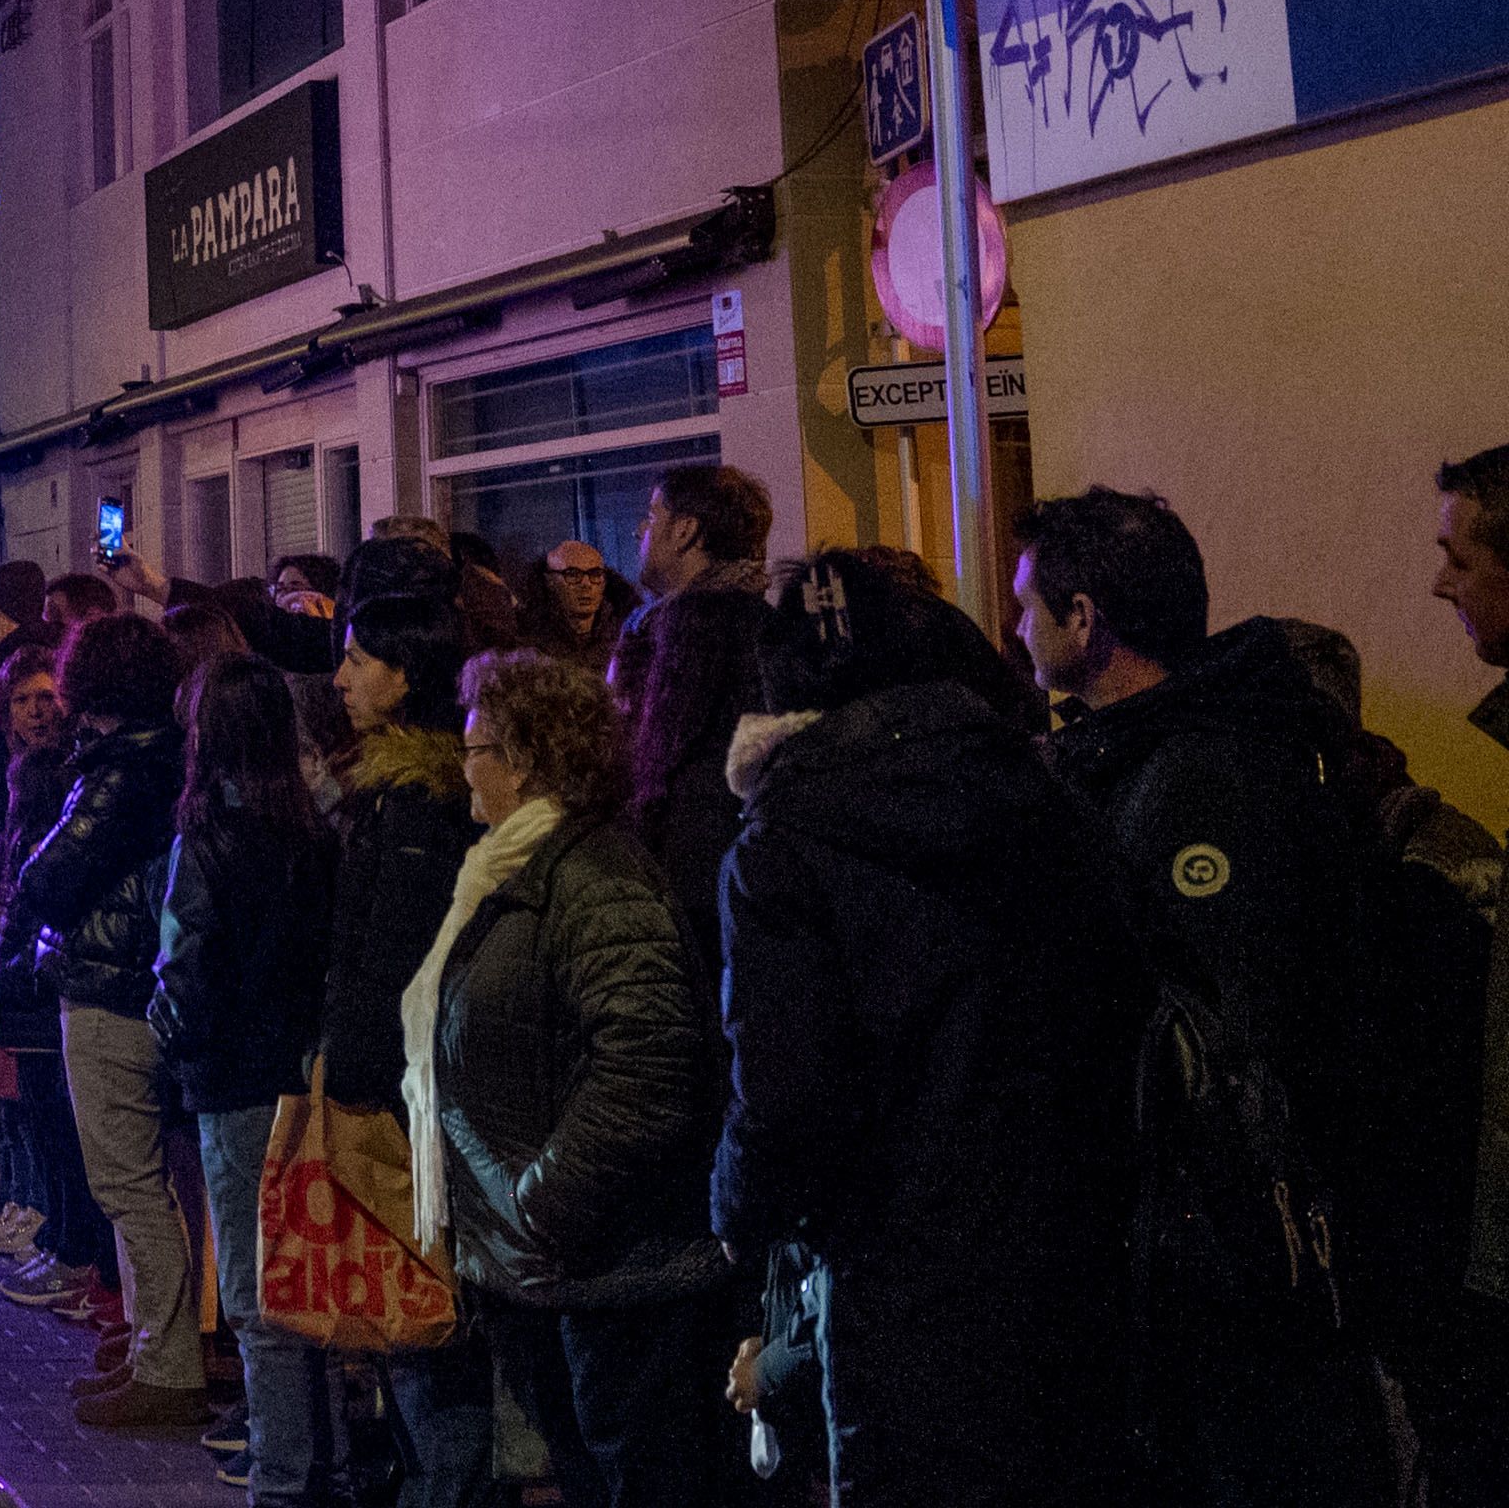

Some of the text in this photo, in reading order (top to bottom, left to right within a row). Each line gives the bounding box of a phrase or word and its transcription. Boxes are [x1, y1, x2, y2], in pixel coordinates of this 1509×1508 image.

[171, 224, 189, 263] LA
[190, 156, 301, 266] PAMPARA
[855, 369, 1027, 407] EXCEPT EÏN
